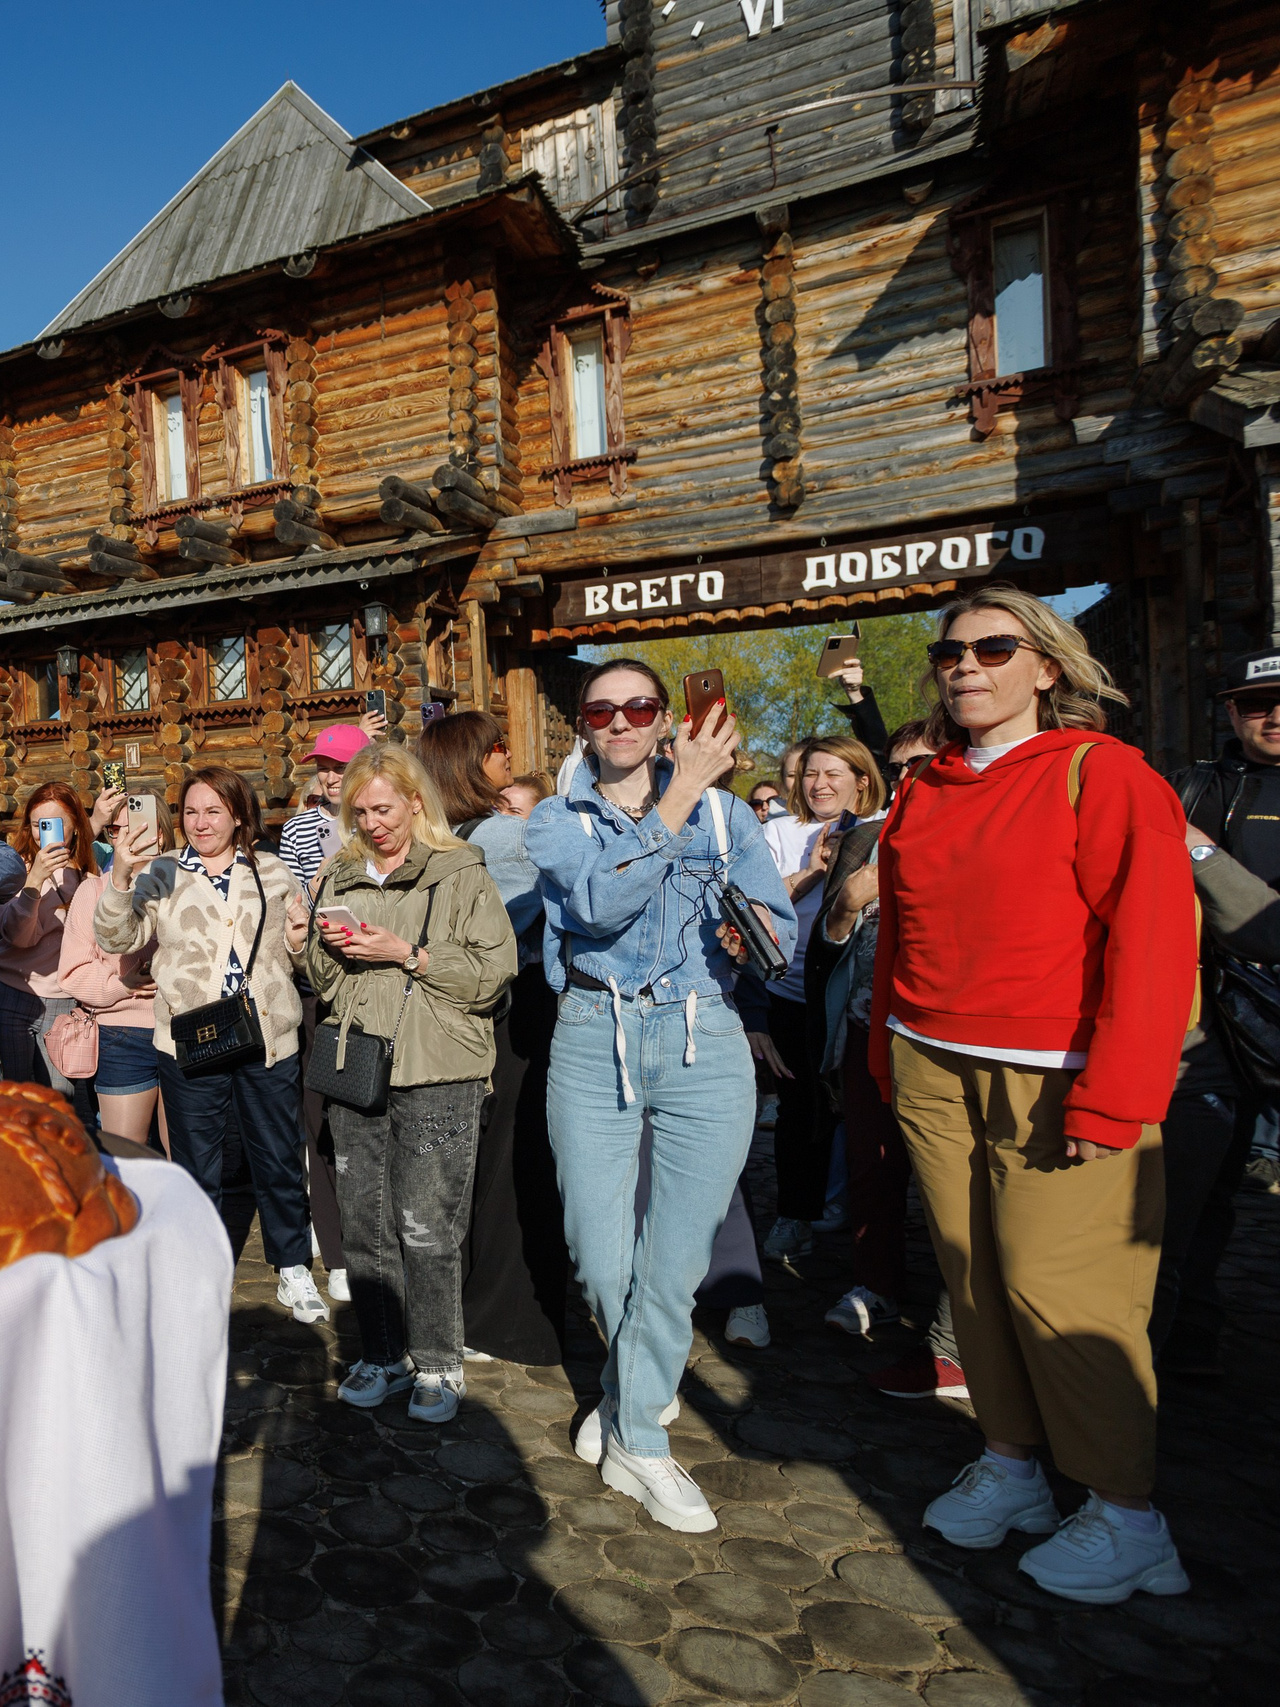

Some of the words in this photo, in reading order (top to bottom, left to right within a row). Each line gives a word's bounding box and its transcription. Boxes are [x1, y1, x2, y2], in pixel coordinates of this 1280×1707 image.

[584, 570, 725, 617] ВСЕГО
[801, 526, 1045, 592] ДОБРОГО
[412, 1121, 468, 1157] LAGERFELD
